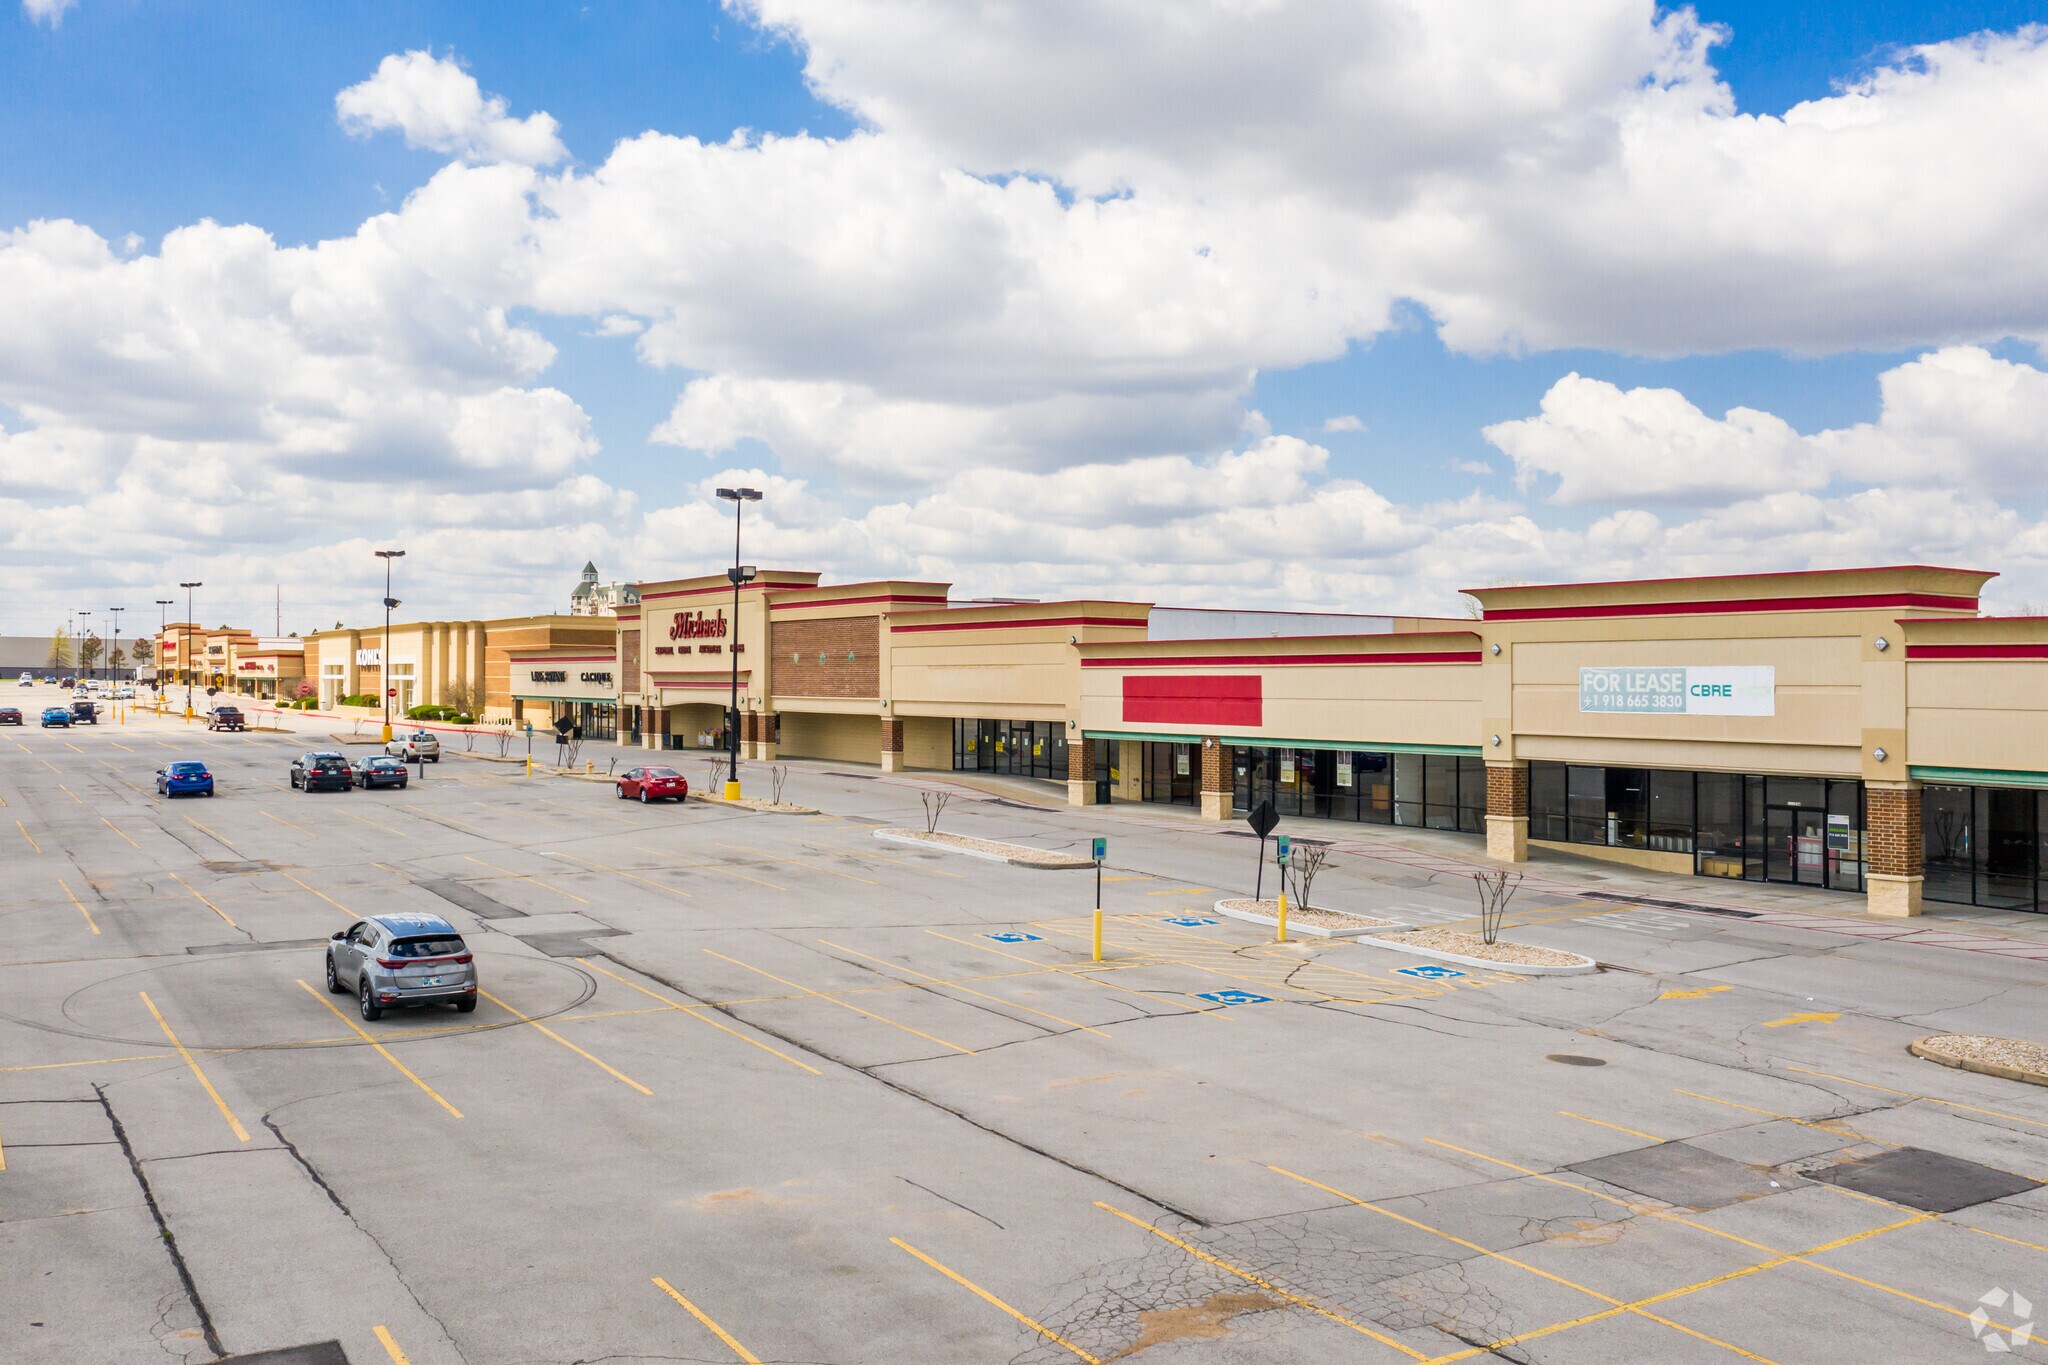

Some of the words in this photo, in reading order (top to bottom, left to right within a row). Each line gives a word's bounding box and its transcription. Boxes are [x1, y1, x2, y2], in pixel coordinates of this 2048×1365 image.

[669, 608, 727, 640] Michaels
[1583, 673, 1620, 692] FOR
[1626, 673, 1682, 692] LEASE
[1690, 684, 1732, 697] CBRE
[1584, 695, 1598, 706] +1
[1603, 695, 1624, 707] 918
[1627, 695, 1649, 707] 665
[1652, 695, 1682, 707] 3830
